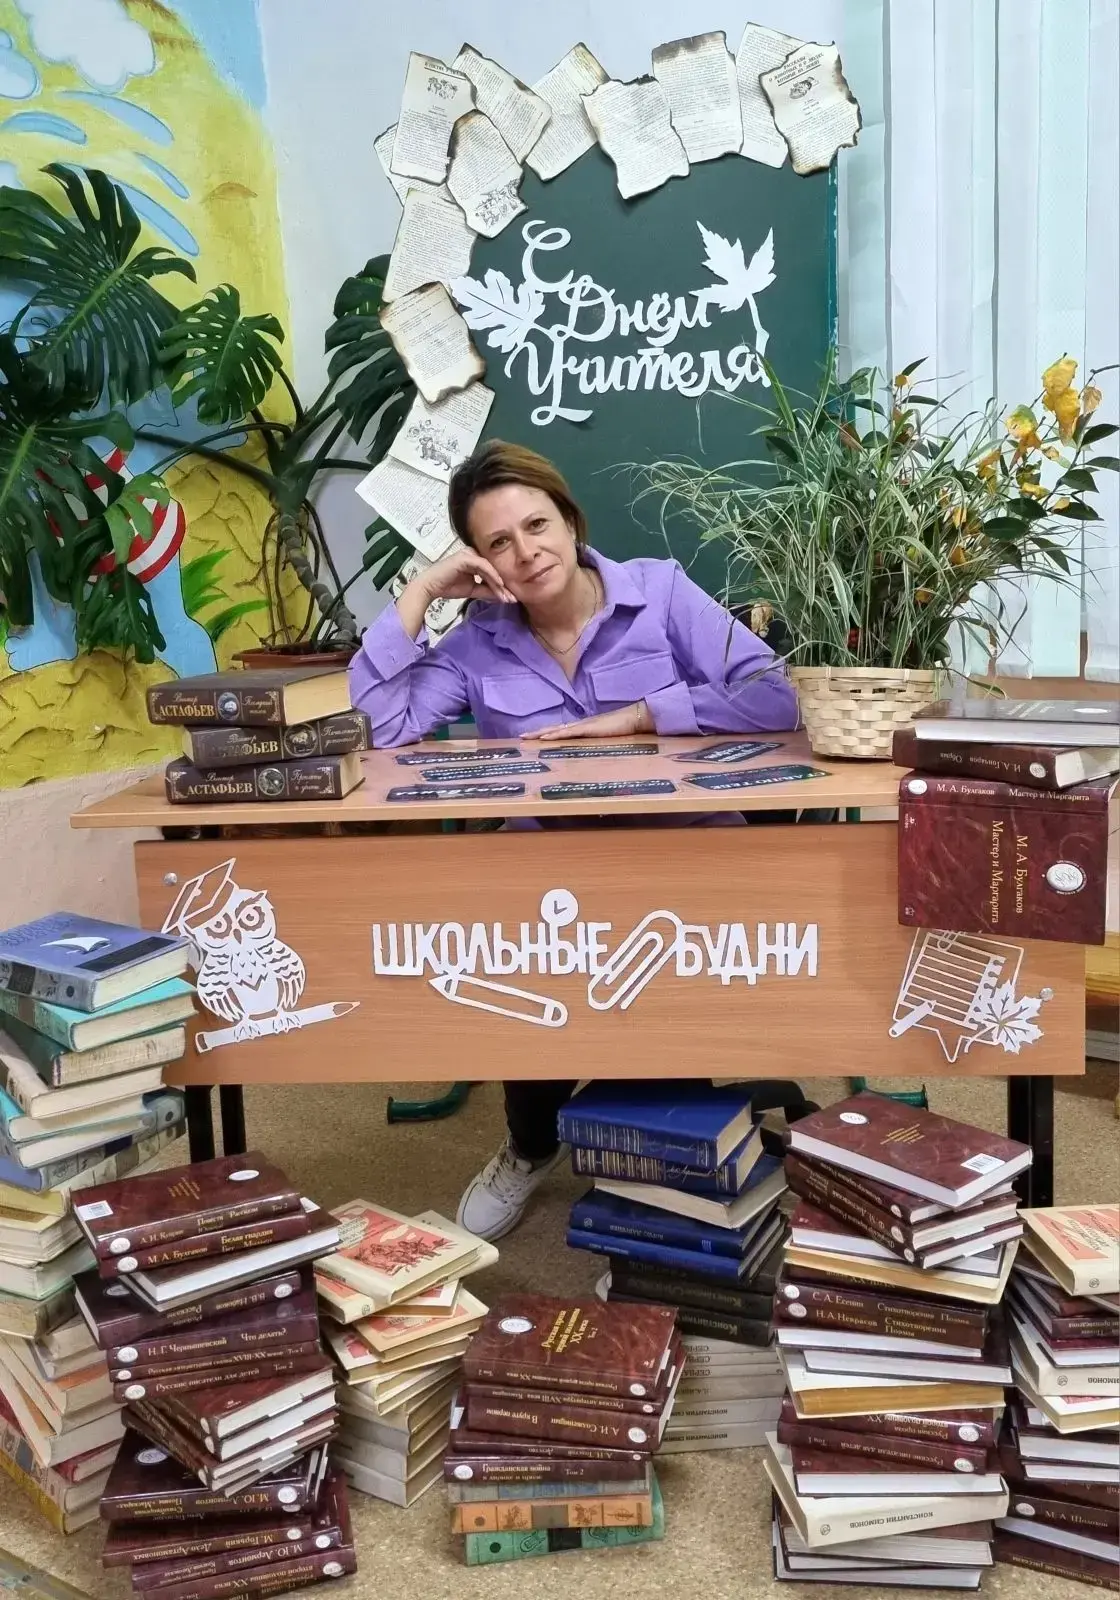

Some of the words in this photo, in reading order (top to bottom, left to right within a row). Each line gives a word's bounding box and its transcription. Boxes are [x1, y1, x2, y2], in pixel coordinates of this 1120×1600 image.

[522, 220, 574, 292] С
[550, 275, 712, 346] Днём
[504, 338, 771, 426] Учителя
[159, 704, 216, 717] АСТАФЬЕВ
[187, 783, 253, 795] АСТАФЬЕВ
[936, 784, 947, 793] М.
[949, 784, 958, 793] А.
[961, 785, 995, 796] Булгаков
[1009, 788, 1038, 799] Мастер
[1047, 791, 1090, 802] Маргарита
[991, 820, 1004, 856] Мастер
[1017, 835, 1028, 848] М.
[1017, 853, 1028, 865] А.
[991, 870, 1004, 923] Маргарита
[1016, 868, 1028, 914] Булгаков
[372, 920, 612, 977] ШКОЛЬНЫЕ
[674, 922, 818, 985] БУДНИ
[148, 1255, 160, 1264] М.
[163, 1252, 172, 1262] А.
[173, 1247, 208, 1260] Булгаков
[838, 1313, 877, 1328] Некрасов
[885, 1317, 947, 1334] Стихотворения
[148, 1347, 158, 1357] Н.
[159, 1346, 168, 1354] Г.
[169, 1337, 227, 1353] Чернышевский
[240, 1332, 256, 1342] Что
[256, 1328, 287, 1341] делать?
[156, 1380, 187, 1392] Русские
[238, 1368, 260, 1378] детей
[531, 1415, 538, 1424] В
[551, 1417, 598, 1433] Солженицын
[608, 1427, 619, 1436] А.
[482, 1464, 528, 1474] Гражданская
[256, 1493, 269, 1501] М.
[849, 1518, 885, 1529] СИМОНОВ
[886, 1511, 933, 1524] КОНСТАНТИН
[225, 1537, 259, 1548] Горький
[262, 1534, 273, 1543] М.
[134, 1546, 189, 1560] Артамоновых
[190, 1542, 212, 1554] Дело
[274, 1546, 290, 1556] Ю.
[291, 1543, 303, 1553] М.
[228, 1550, 272, 1566] Лермонтов
